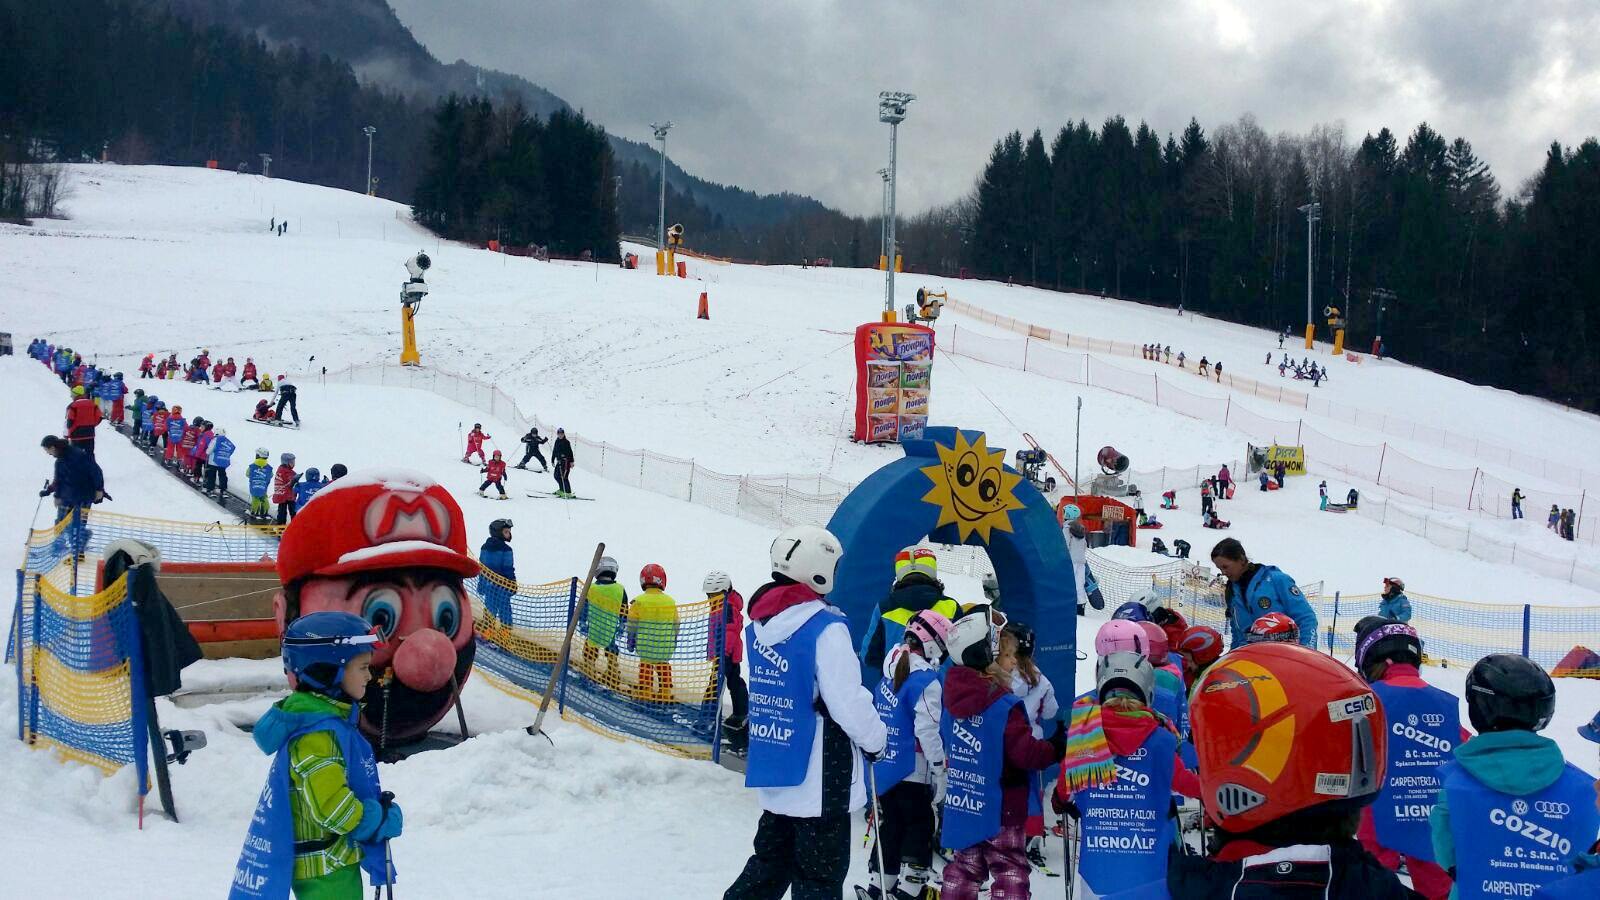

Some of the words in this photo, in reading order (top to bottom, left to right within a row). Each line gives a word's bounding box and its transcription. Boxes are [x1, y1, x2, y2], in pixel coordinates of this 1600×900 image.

[375, 494, 442, 540] M
[753, 639, 789, 673] COZZIO
[1344, 701, 1364, 714] CSI
[952, 722, 982, 753] OZZIO
[1392, 722, 1452, 752] COZZIO
[1405, 750, 1412, 758] &
[1412, 750, 1421, 758] C.
[1390, 776, 1438, 787] CARPENTERIA
[1489, 808, 1571, 855] COZZIO
[1504, 846, 1512, 857] &
[1515, 847, 1527, 858] C.
[1530, 850, 1560, 861] s.n.c.
[1490, 859, 1518, 868] Spiazzo
[1520, 861, 1554, 871] Rendena
